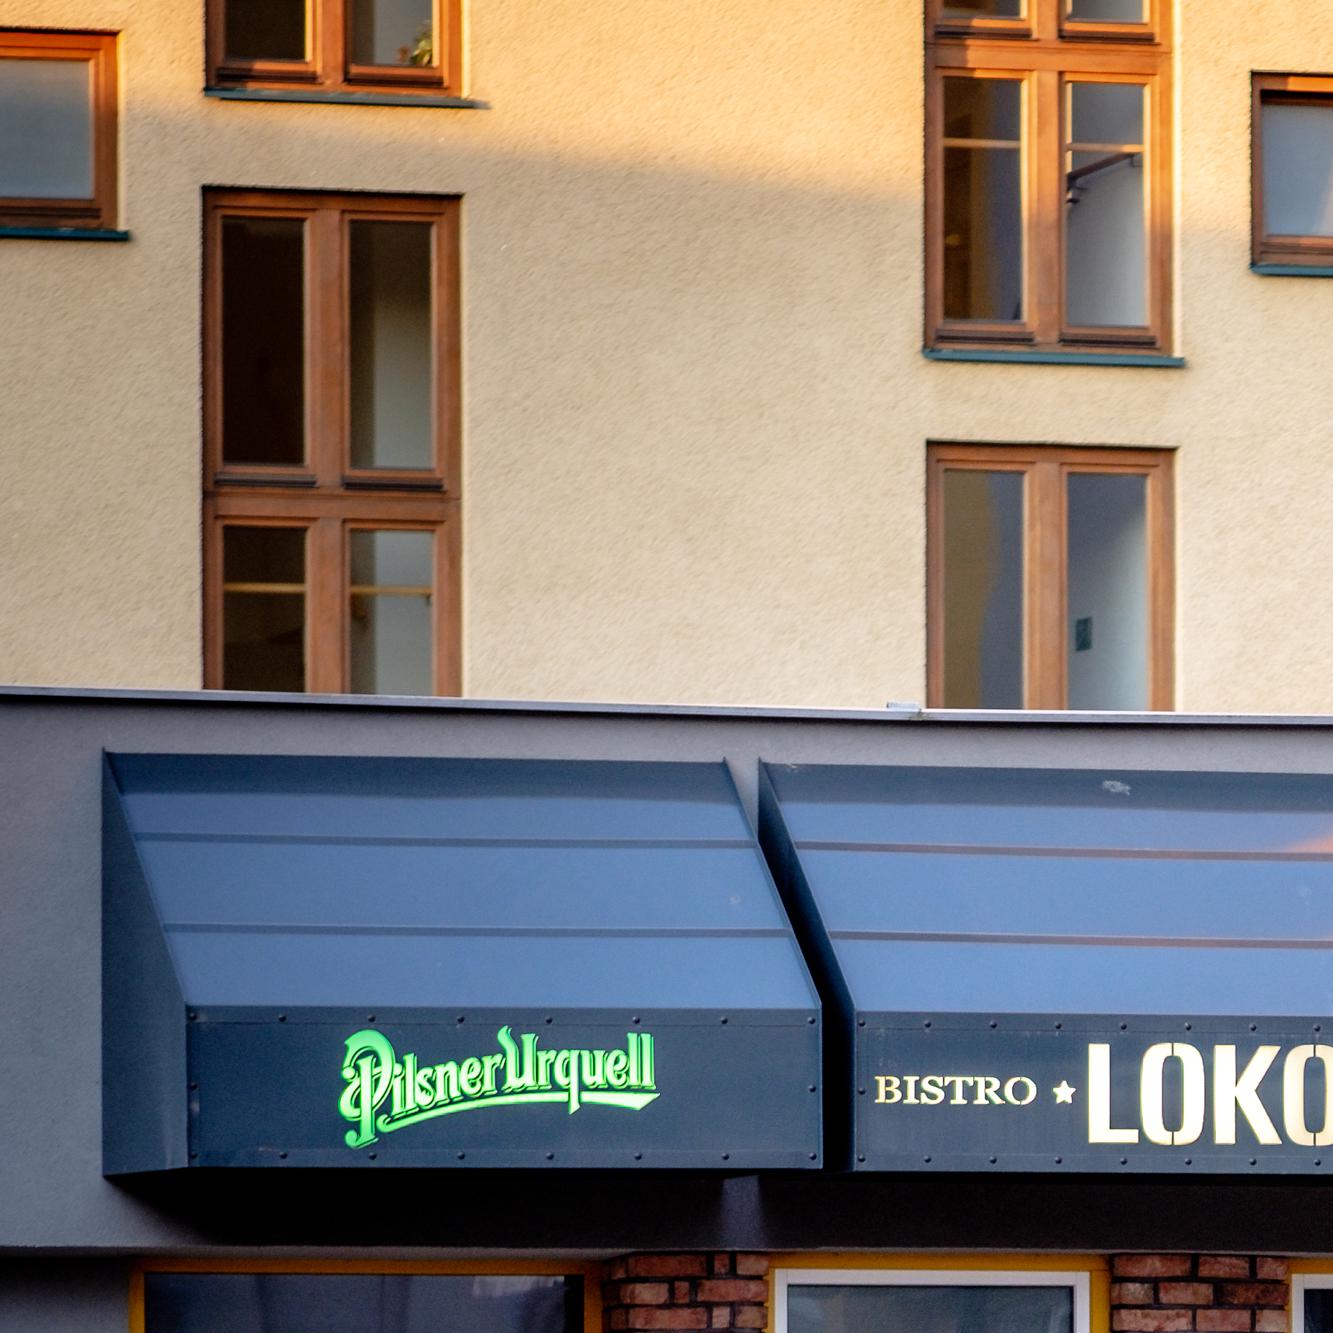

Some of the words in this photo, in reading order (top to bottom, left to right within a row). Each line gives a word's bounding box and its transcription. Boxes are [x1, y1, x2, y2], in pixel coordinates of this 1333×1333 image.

[338, 1028, 504, 1150] Pilsner
[497, 1025, 657, 1115] Urquell
[874, 1074, 1038, 1106] BISTRO
